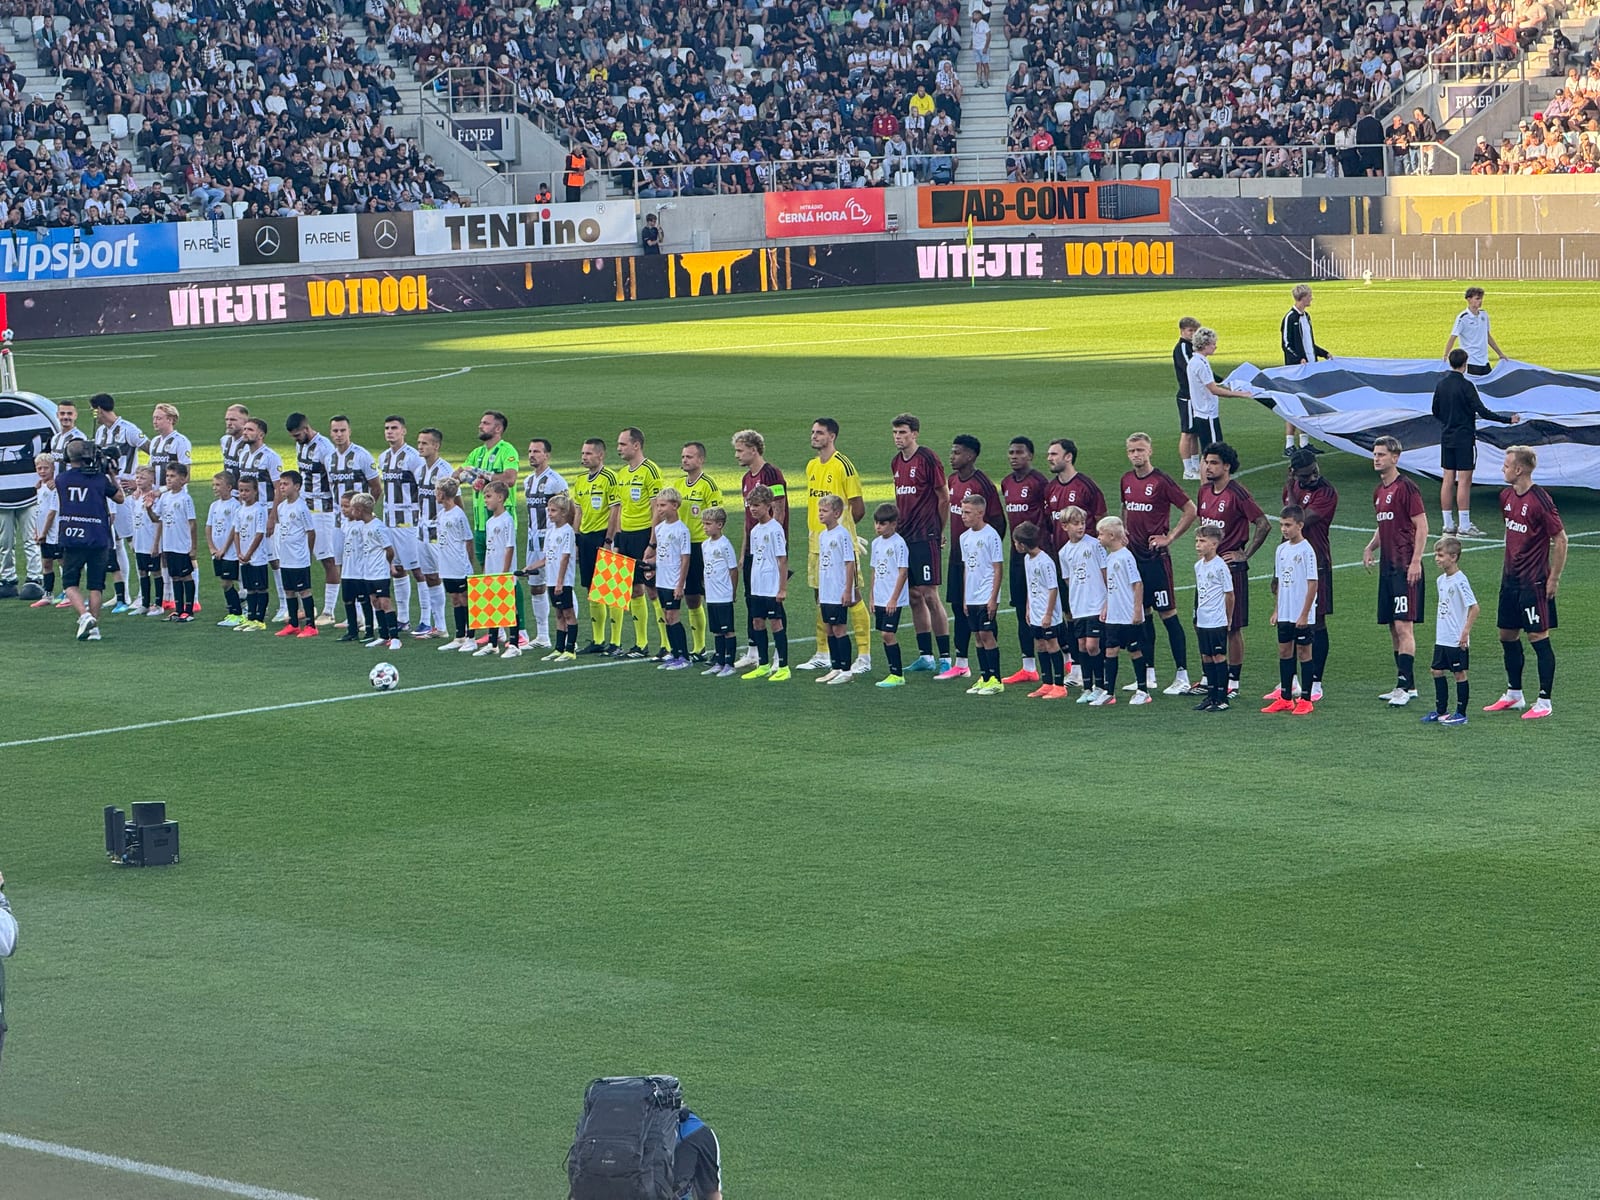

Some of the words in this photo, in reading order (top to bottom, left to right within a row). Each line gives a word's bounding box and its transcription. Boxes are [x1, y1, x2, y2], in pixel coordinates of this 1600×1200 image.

[1455, 95, 1493, 109] FINEP
[457, 128, 495, 142] FINEP
[964, 186, 1090, 223] AB-CONT
[778, 211, 814, 223] ČERNÁ
[816, 211, 847, 222] HORA
[445, 208, 600, 250] TENTino
[0, 233, 139, 280] Tipsport
[917, 242, 1044, 279] VÍTEJTE
[1065, 241, 1174, 276] VOTROCI
[169, 282, 287, 327] VÍTEJTE
[307, 274, 428, 317] VOTROCI
[68, 487, 88, 502] TV
[65, 527, 85, 538] 072
[923, 565, 931, 581] 6
[1154, 591, 1169, 607] 30
[1394, 595, 1408, 614] 28
[1525, 606, 1540, 625] 14
